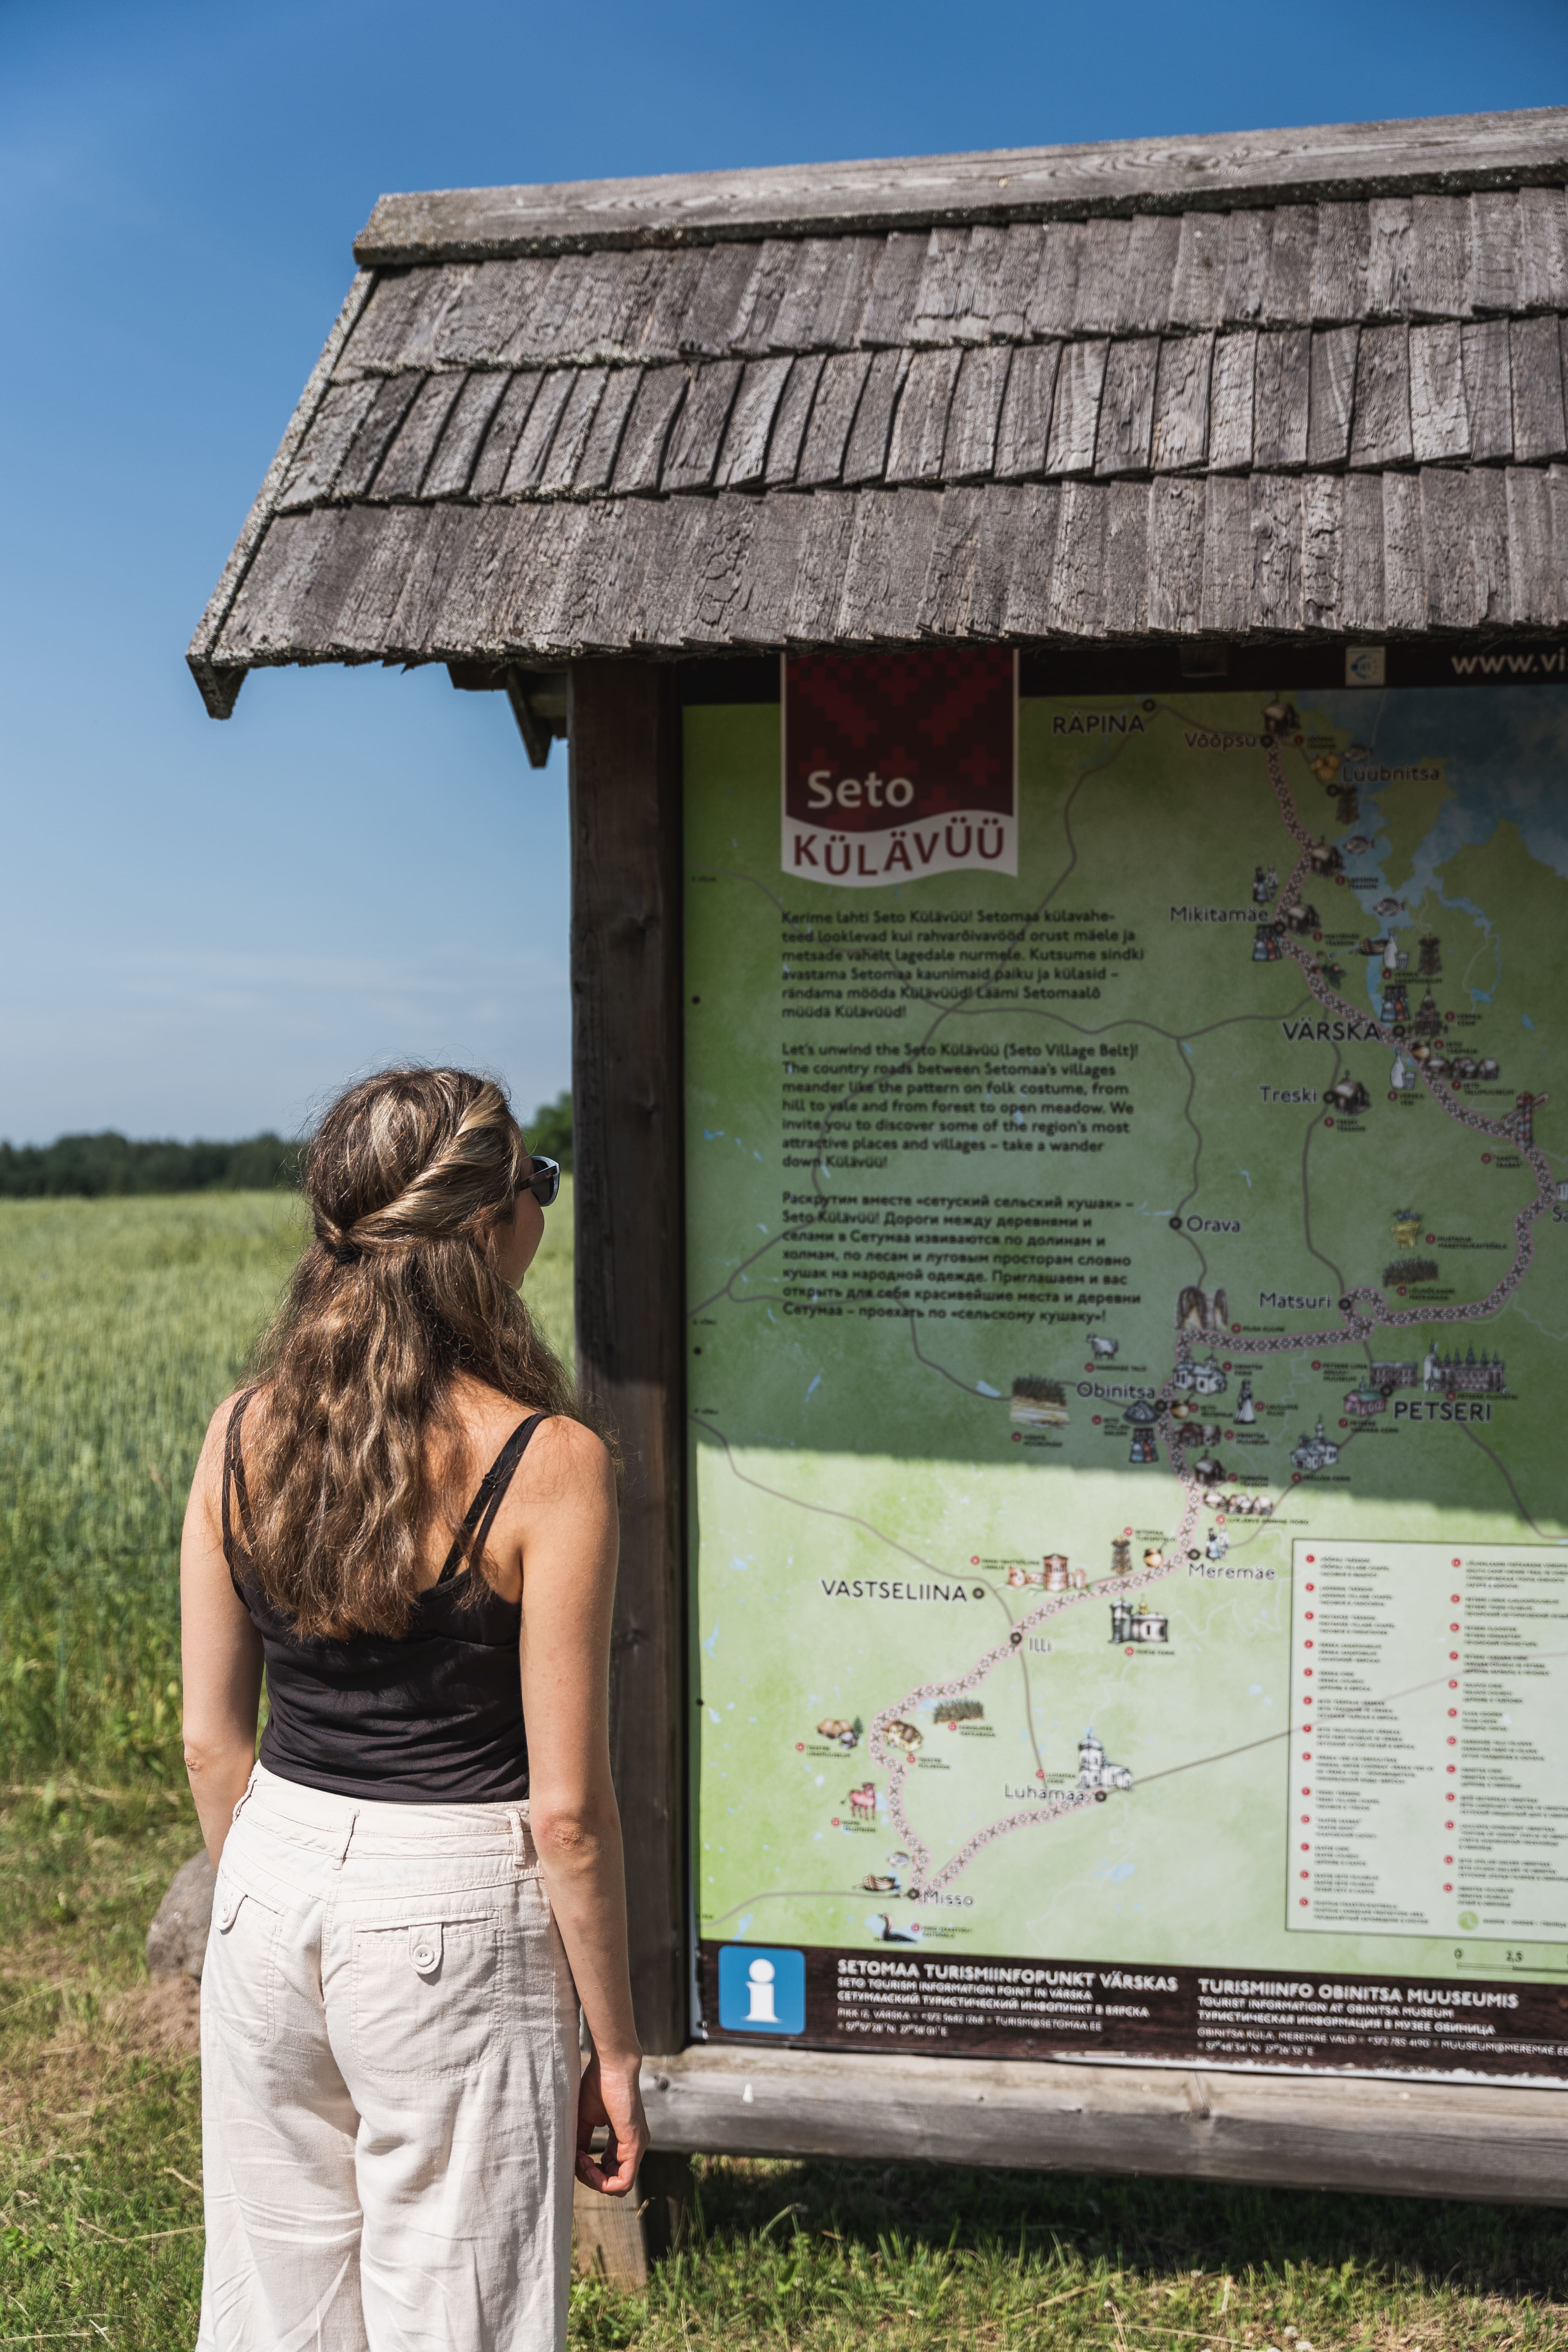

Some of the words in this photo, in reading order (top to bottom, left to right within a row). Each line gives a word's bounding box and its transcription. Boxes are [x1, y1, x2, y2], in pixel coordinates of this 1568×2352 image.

[1053, 709, 1145, 735] RÄPINA
[1343, 764, 1439, 782] Lüübnitsa
[808, 770, 914, 808] Seto
[794, 816, 1004, 876] KÜLÄVÜÜ
[782, 911, 832, 924] Kerime
[837, 910, 869, 924] lahti
[873, 910, 906, 923] Seto
[977, 910, 1040, 923] Setomaa
[1170, 906, 1269, 923] Mikitamäe
[781, 929, 814, 942] teed
[818, 929, 887, 942] looklevad
[891, 929, 912, 942] kui
[917, 929, 1025, 942] rahvarõivavööd
[1030, 930, 1069, 942] orust
[1074, 929, 1119, 942] mäele
[782, 948, 842, 961] metsade
[848, 948, 891, 961] vahelt
[895, 948, 955, 965] lagedale
[1029, 948, 1096, 961] Kutsume
[1100, 948, 1144, 961] sindki
[782, 968, 846, 980] avastama
[851, 967, 912, 980] Setomaa
[916, 967, 989, 980] kaunimaid
[994, 967, 1033, 984] paiku
[1054, 967, 1107, 980] külasid
[782, 986, 843, 999] rändama
[847, 986, 896, 999] mööda
[976, 986, 1019, 999] Läämi
[1023, 986, 1101, 999] Setomaalõ
[782, 1005, 831, 1018] müüdä
[1282, 1017, 1381, 1041] VÄRSKA
[818, 1042, 871, 1056] unwind
[875, 1043, 900, 1056] the
[904, 1043, 936, 1056] Seto
[940, 1043, 999, 1056] Külävüü
[1045, 1043, 1095, 1061] Village
[782, 1062, 809, 1074] The
[813, 1063, 869, 1079] country
[874, 1062, 913, 1075] roads
[917, 1062, 980, 1075] between
[1061, 1063, 1116, 1080] villages
[782, 1080, 844, 1094] meander
[849, 1081, 874, 1094] like
[878, 1081, 903, 1094] the
[906, 1082, 959, 1098] pattern
[963, 1084, 982, 1094] on
[986, 1081, 1015, 1094] folk
[1092, 1082, 1129, 1094] from
[1259, 1085, 1318, 1104] Treski
[782, 1099, 805, 1112] hill
[809, 1100, 825, 1112] to
[829, 1099, 857, 1112] vale
[862, 1099, 888, 1112] and
[892, 1100, 927, 1112] from
[931, 1100, 976, 1113] forest
[979, 1101, 995, 1113] to
[1000, 1103, 1036, 1118] open
[1110, 1101, 1134, 1114] We
[782, 1118, 820, 1131] invite
[825, 1122, 851, 1136] you
[855, 1120, 871, 1131] to
[875, 1118, 935, 1132] discover
[939, 1122, 978, 1132] some
[982, 1119, 998, 1132] of
[1002, 1119, 1027, 1132] the
[1091, 1121, 1129, 1133] most
[782, 1136, 848, 1149] attractive
[852, 1136, 898, 1154] places
[902, 1137, 928, 1150] and
[932, 1137, 986, 1155] villages
[1002, 1138, 1033, 1151] take
[1037, 1142, 1045, 1151] a
[1049, 1138, 1104, 1152] wander
[782, 1154, 821, 1167] down
[782, 1210, 814, 1223] Seto
[1187, 1215, 1241, 1233] Orava
[1259, 1291, 1332, 1309] Matsuri
[1077, 1381, 1156, 1400] Obinitsa
[1394, 1401, 1491, 1422] PETSERI
[1188, 1563, 1276, 1580] Meremäe
[822, 1580, 967, 1602] VASTSELIINA
[1005, 1784, 1085, 1801] Luhamaa
[924, 1891, 975, 1907] Misso
[838, 1959, 919, 1979] SETOMAA
[924, 1964, 1095, 1988] TURISMIINFOPUNKT
[1100, 1969, 1178, 1992] VÄRSKAS
[837, 1977, 866, 1990] SETO
[867, 1978, 917, 1993] TOURISM
[919, 1981, 995, 1996] INFORMATION
[997, 1985, 1031, 1998] POINT
[1034, 1987, 1047, 1999] IN
[1049, 1985, 1093, 2002] VÄRSKA
[1198, 1978, 1314, 1999] TURISMIINFO
[1318, 1984, 1403, 2004] OBINITSA
[1407, 1989, 1519, 2009] MUUSEUMIS
[1198, 1995, 1246, 2009] TOURIST
[1249, 1998, 1328, 2013] INFORMATION
[1329, 2002, 1344, 2014] AT
[1347, 2003, 1400, 2017] OBINITSA
[1402, 2005, 1454, 2020] MUSEUM
